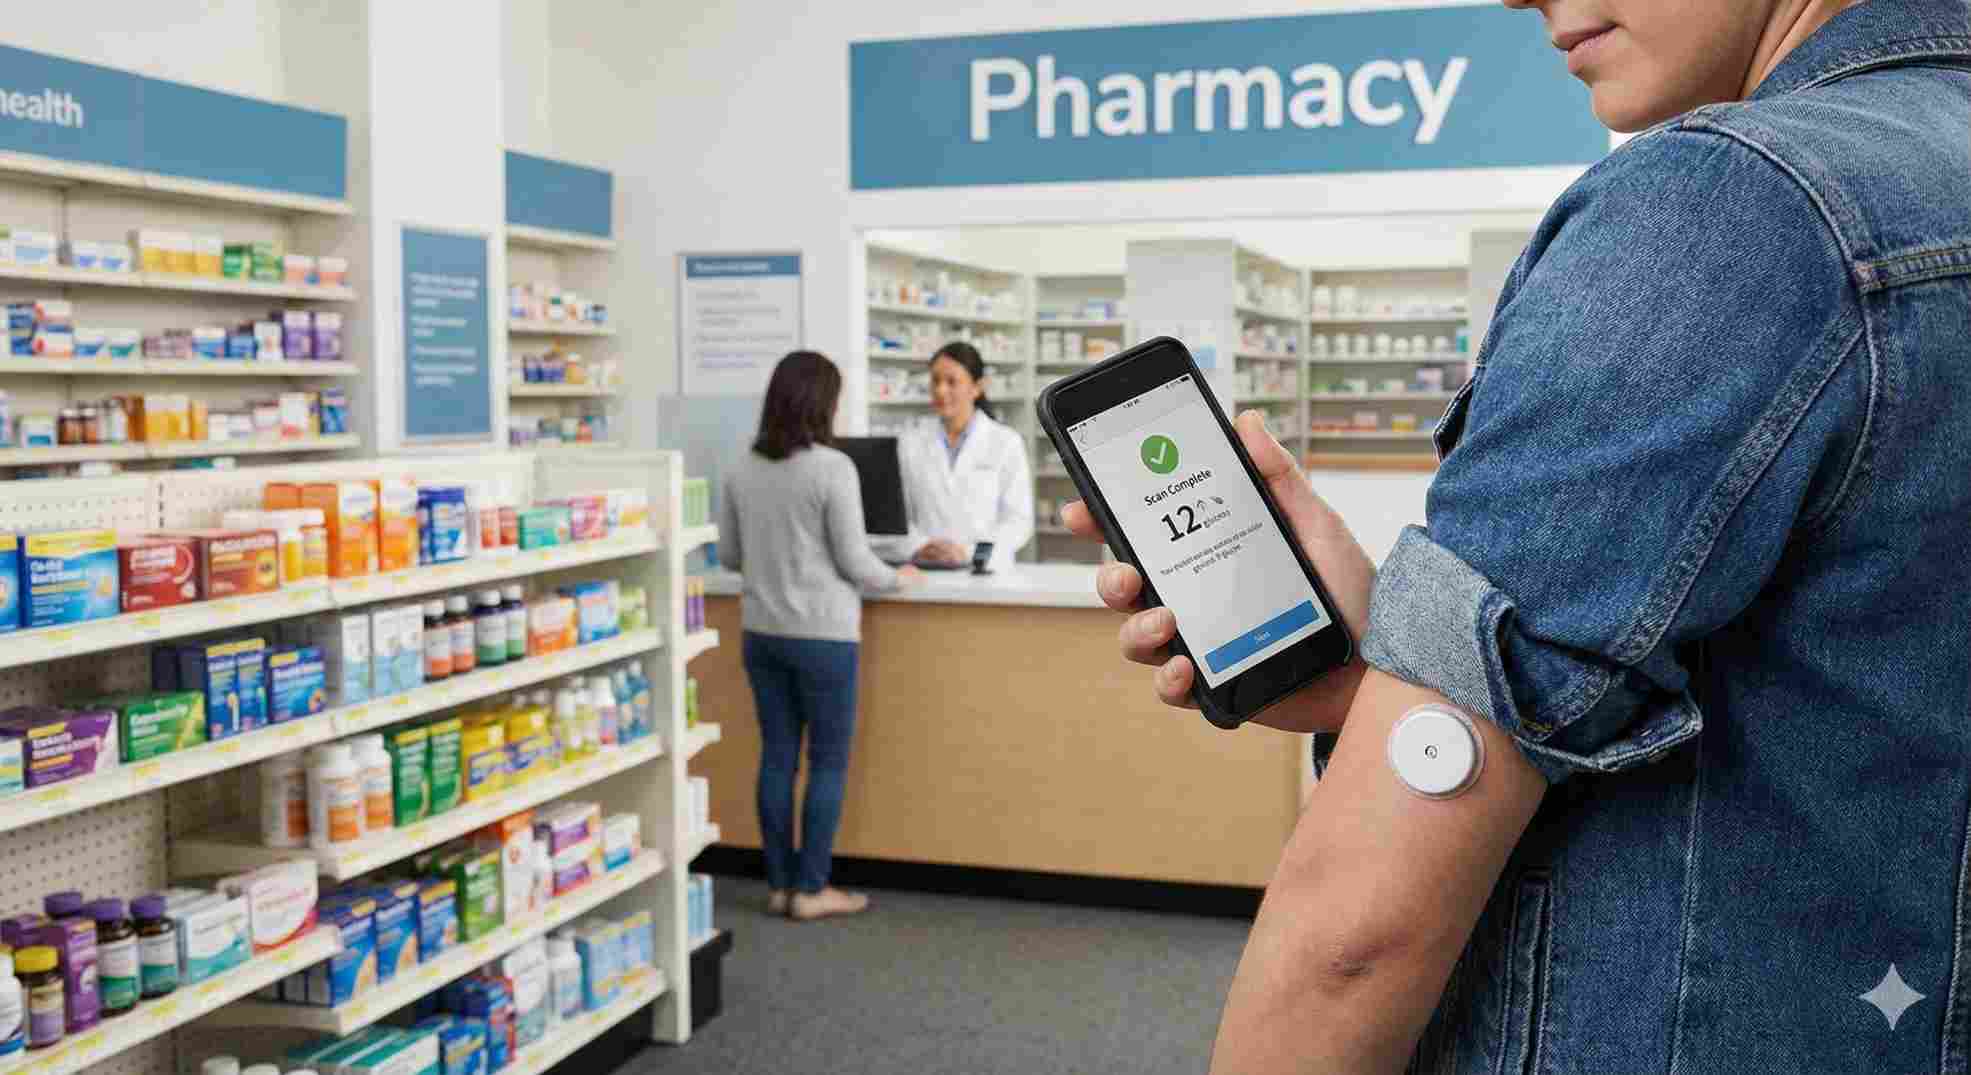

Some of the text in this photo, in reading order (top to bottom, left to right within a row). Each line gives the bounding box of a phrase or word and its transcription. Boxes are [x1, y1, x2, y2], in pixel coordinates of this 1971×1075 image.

[969, 55, 1468, 144] Pharmacy
[1144, 469, 1212, 506] Scan Complete
[1161, 505, 1202, 542] 12
